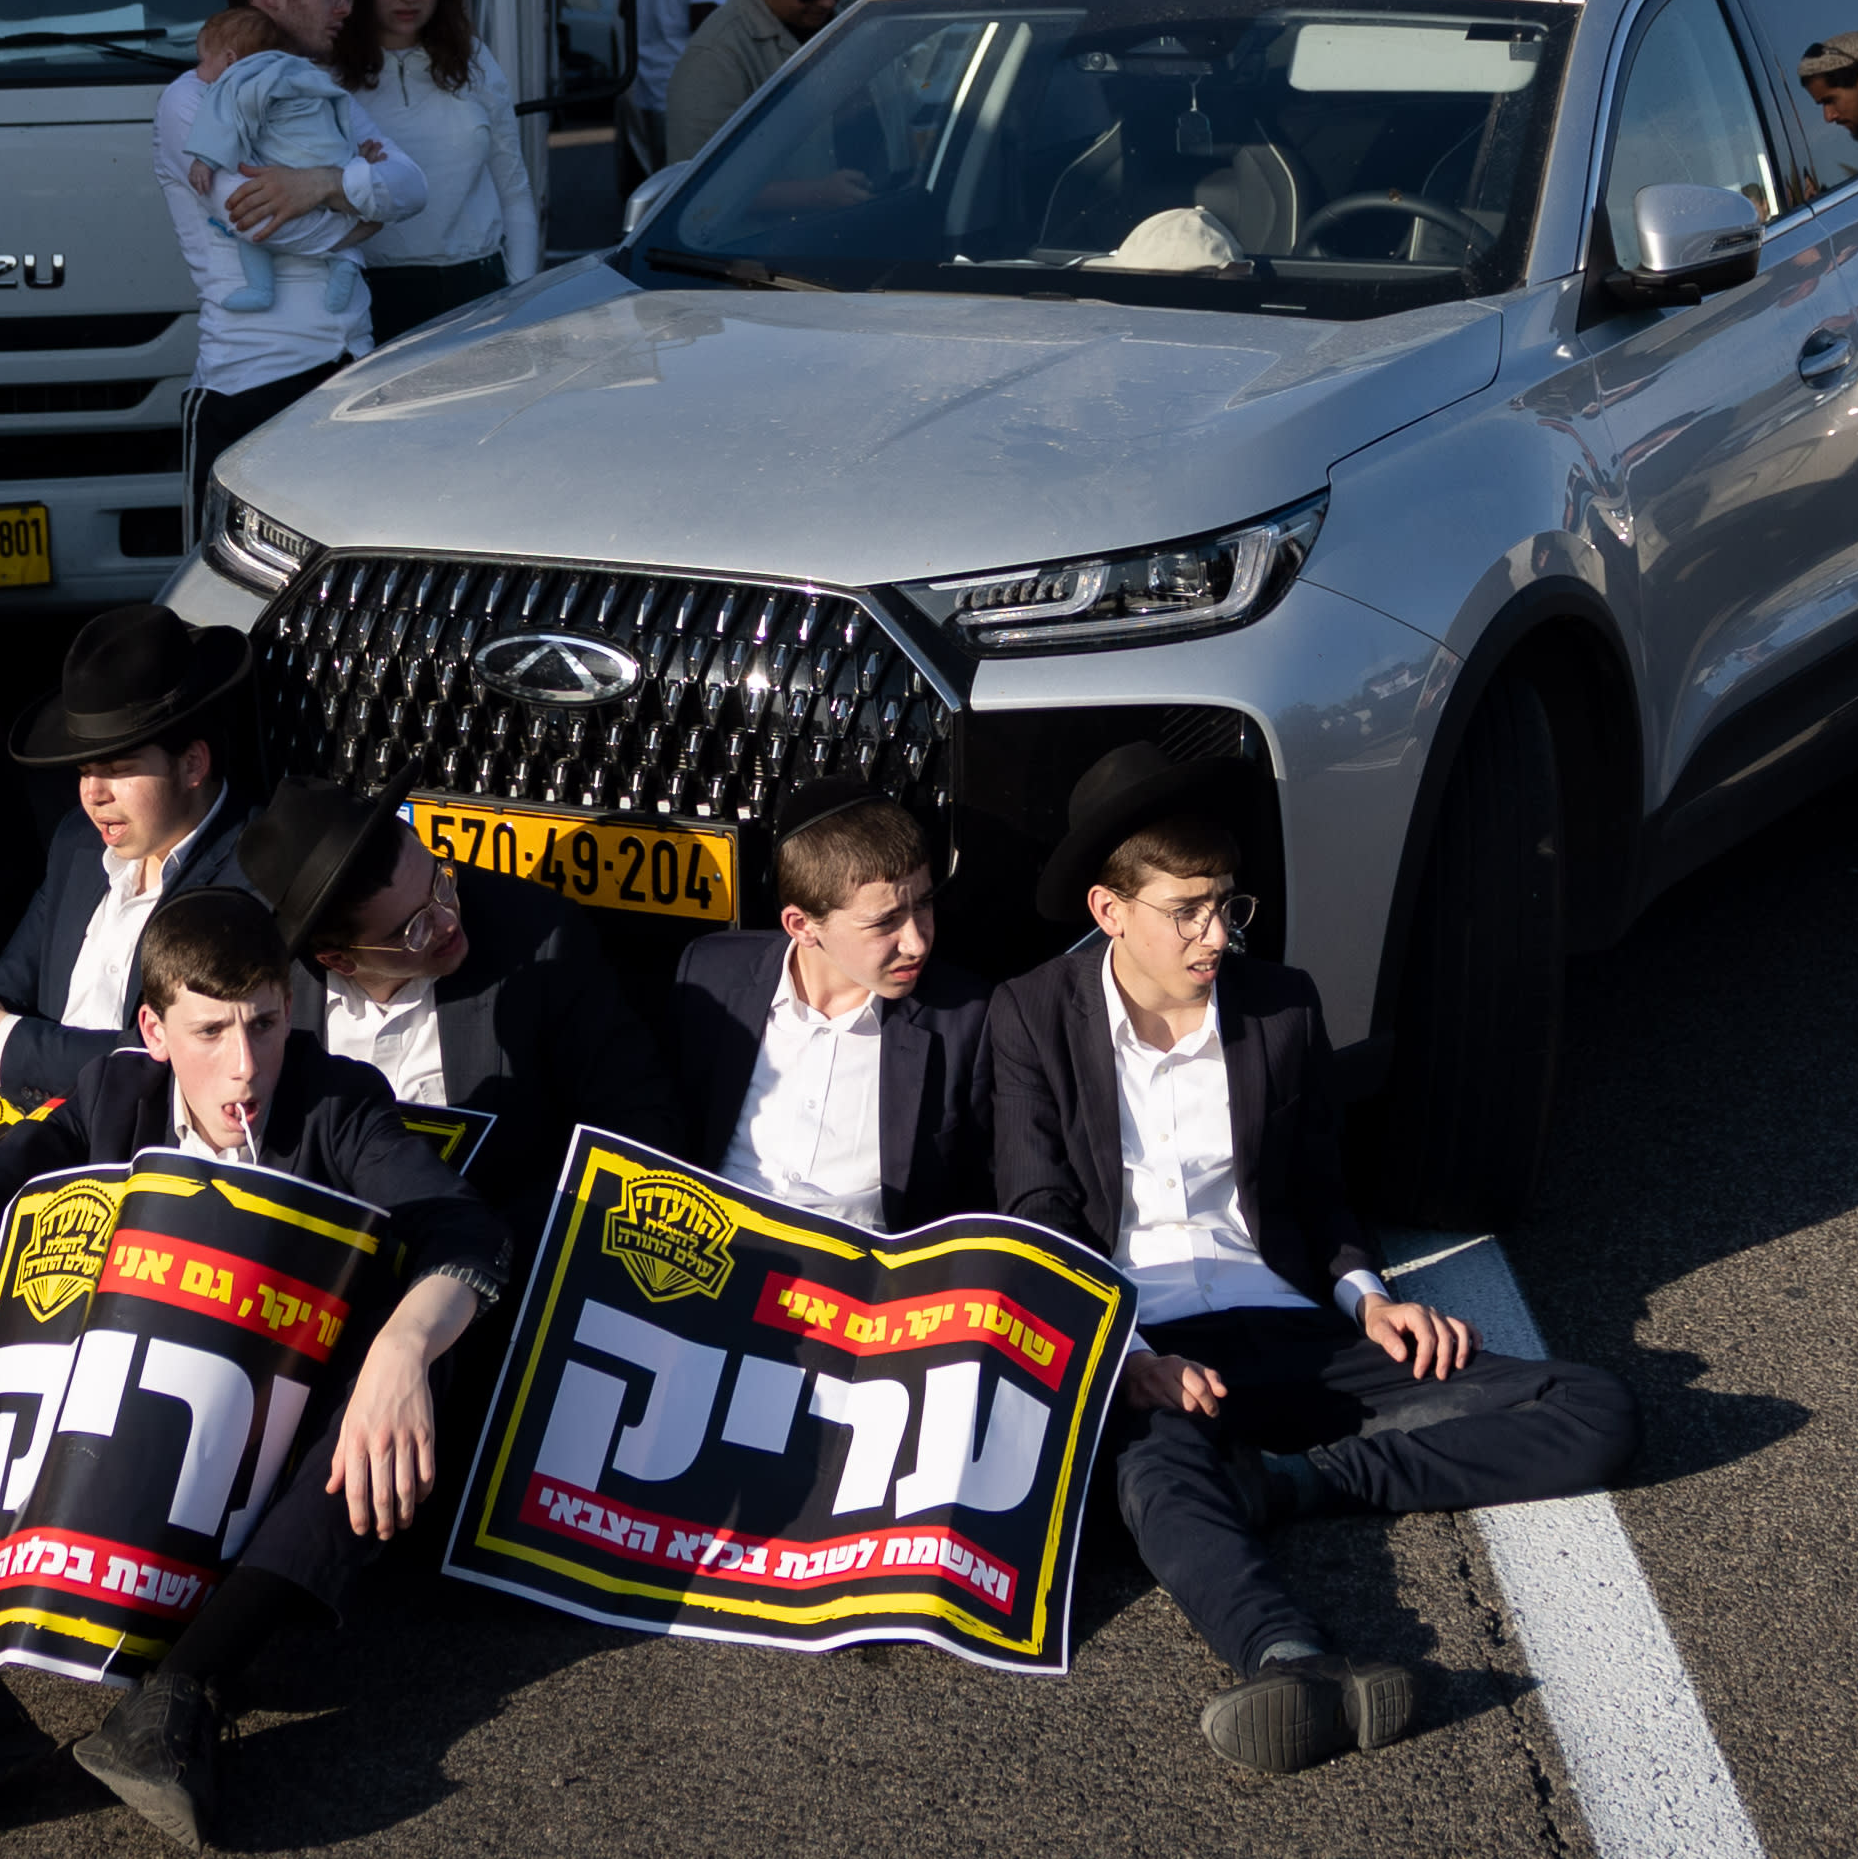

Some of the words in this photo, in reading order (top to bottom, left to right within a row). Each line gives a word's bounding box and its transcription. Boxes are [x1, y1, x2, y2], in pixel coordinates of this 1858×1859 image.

[431, 814, 713, 910] 570-49-204
[635, 1185, 722, 1239] הוועדה
[643, 1217, 699, 1250] להצלת
[617, 1225, 672, 1257] התורה
[673, 1248, 715, 1278] עולם
[112, 1245, 174, 1285] אני
[179, 1259, 234, 1305] גם
[237, 1283, 312, 1331] יקר,
[777, 1289, 840, 1330] אני
[843, 1312, 888, 1343] גם
[890, 1303, 955, 1345] יקר,
[963, 1302, 1056, 1367] שוטר
[535, 1298, 1052, 1520] עריק
[538, 1486, 660, 1554] הצבאי
[10, 1535, 96, 1584] בכלא
[666, 1529, 767, 1576] בכלא
[773, 1536, 872, 1581] לשבת
[881, 1536, 1011, 1603] ואשמח
[100, 1555, 203, 1610] לשבת
